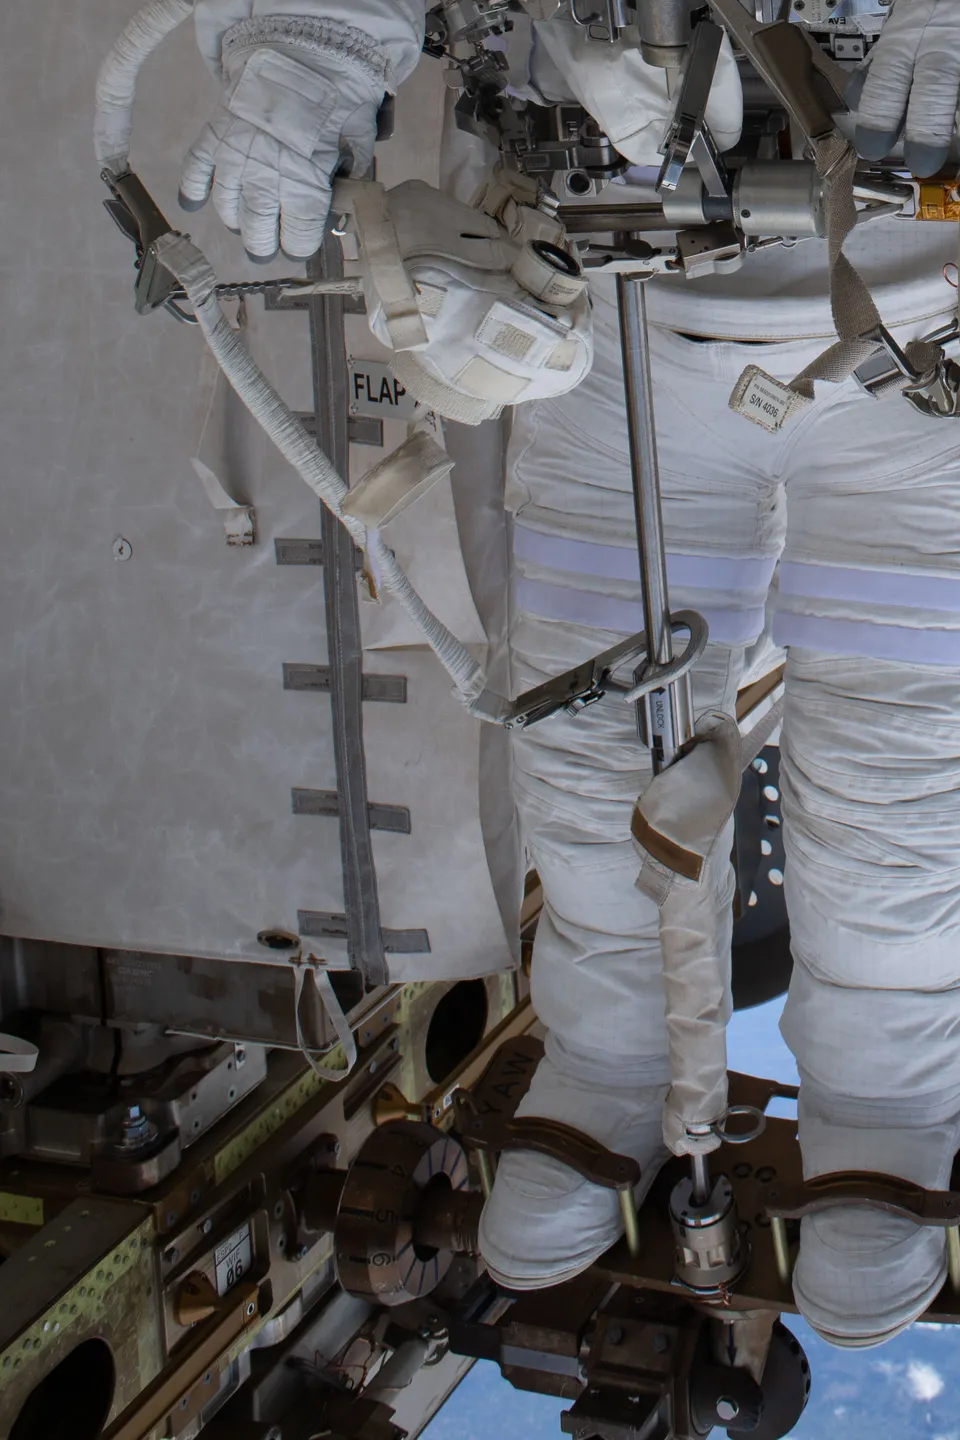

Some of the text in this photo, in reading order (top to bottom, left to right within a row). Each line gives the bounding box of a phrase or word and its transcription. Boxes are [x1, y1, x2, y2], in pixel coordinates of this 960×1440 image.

[354, 372, 407, 406] FLAP
[749, 393, 763, 408] S/N
[762, 402, 779, 418] 4036
[655, 700, 665, 729] UNLOCK
[481, 1051, 535, 1115] YAW
[389, 1164, 407, 1178] 4
[375, 1208, 396, 1223] 5
[226, 1247, 241, 1268] WIF
[372, 1252, 391, 1267] 6
[226, 1258, 243, 1290] 06
